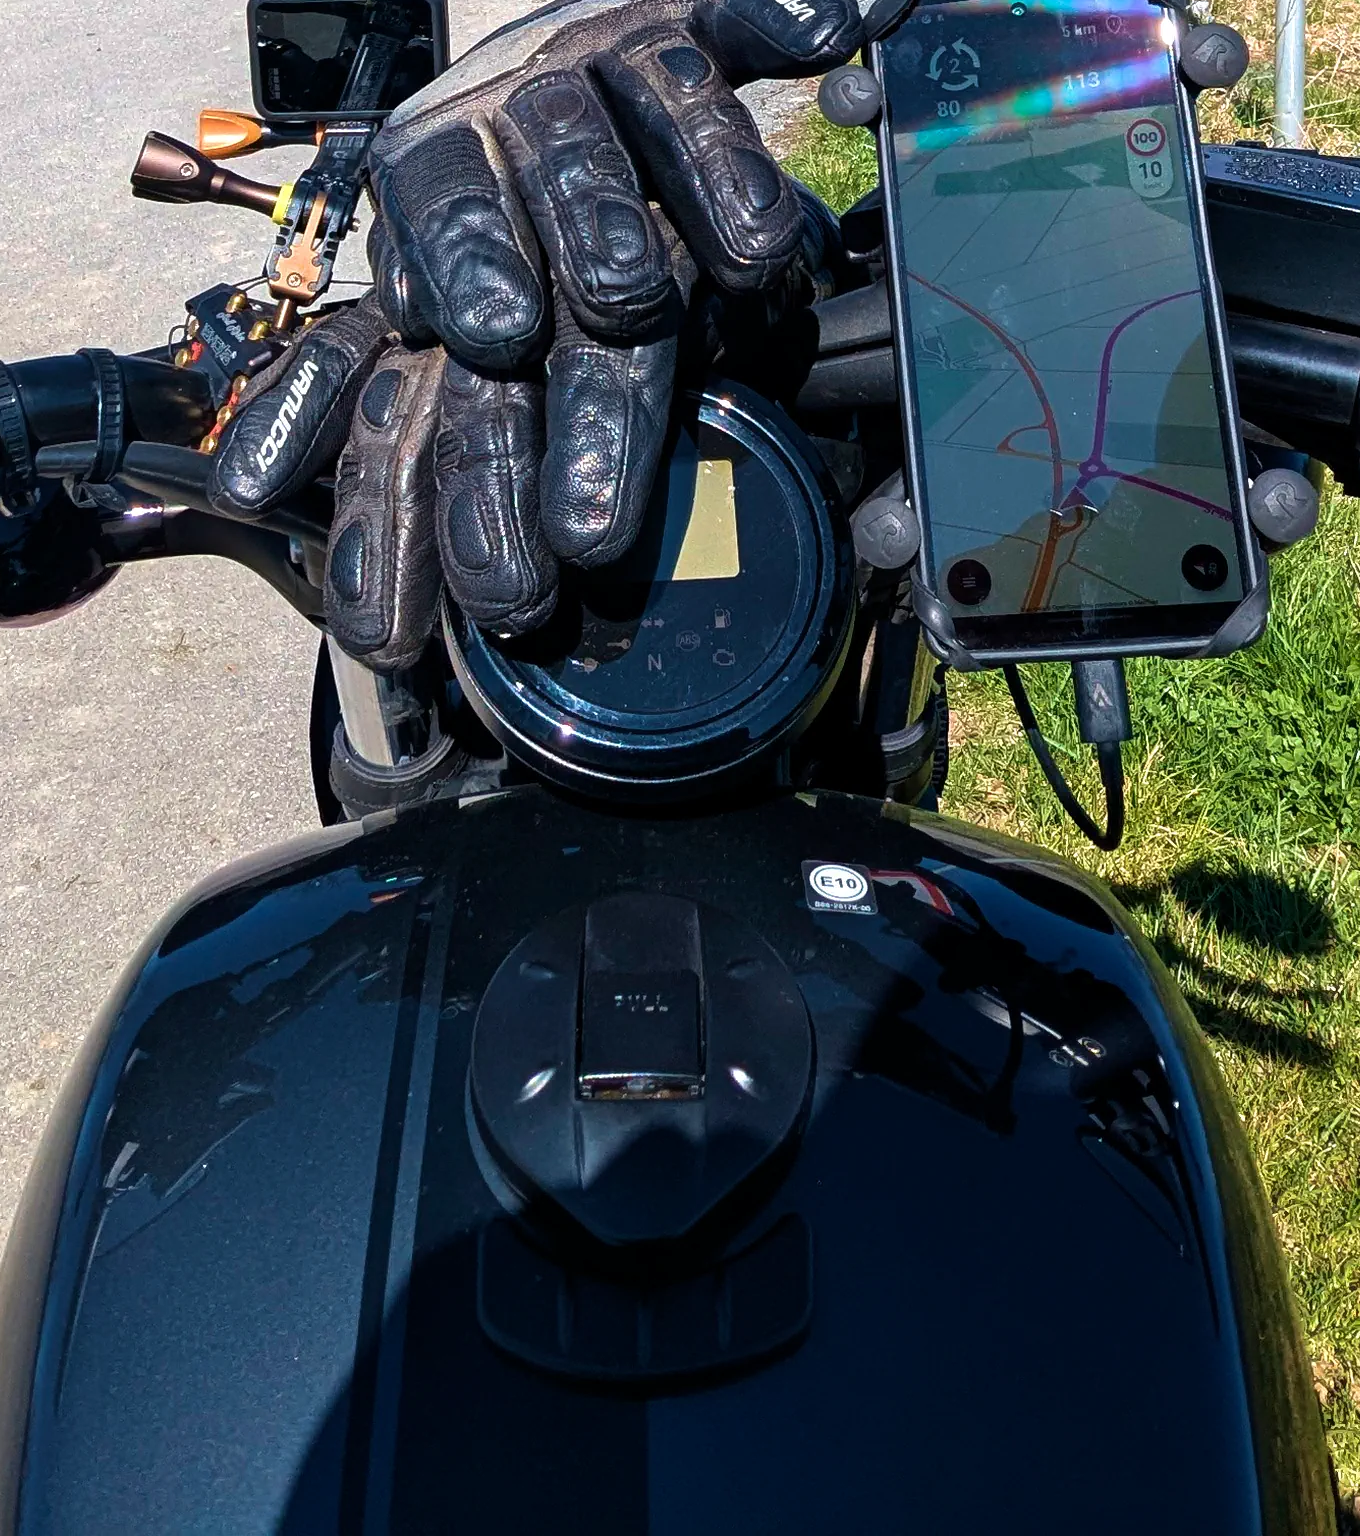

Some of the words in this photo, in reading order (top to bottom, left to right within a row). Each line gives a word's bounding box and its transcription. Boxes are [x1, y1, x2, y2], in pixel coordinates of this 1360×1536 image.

[949, 58, 961, 74] 2
[1063, 71, 1101, 91] 113
[937, 100, 960, 118] 80
[1133, 131, 1158, 145] 100
[1139, 161, 1163, 179] 10
[255, 360, 319, 473] VANUCCI
[679, 633, 697, 645] ABS
[647, 653, 662, 671] N
[821, 875, 858, 890] E10
